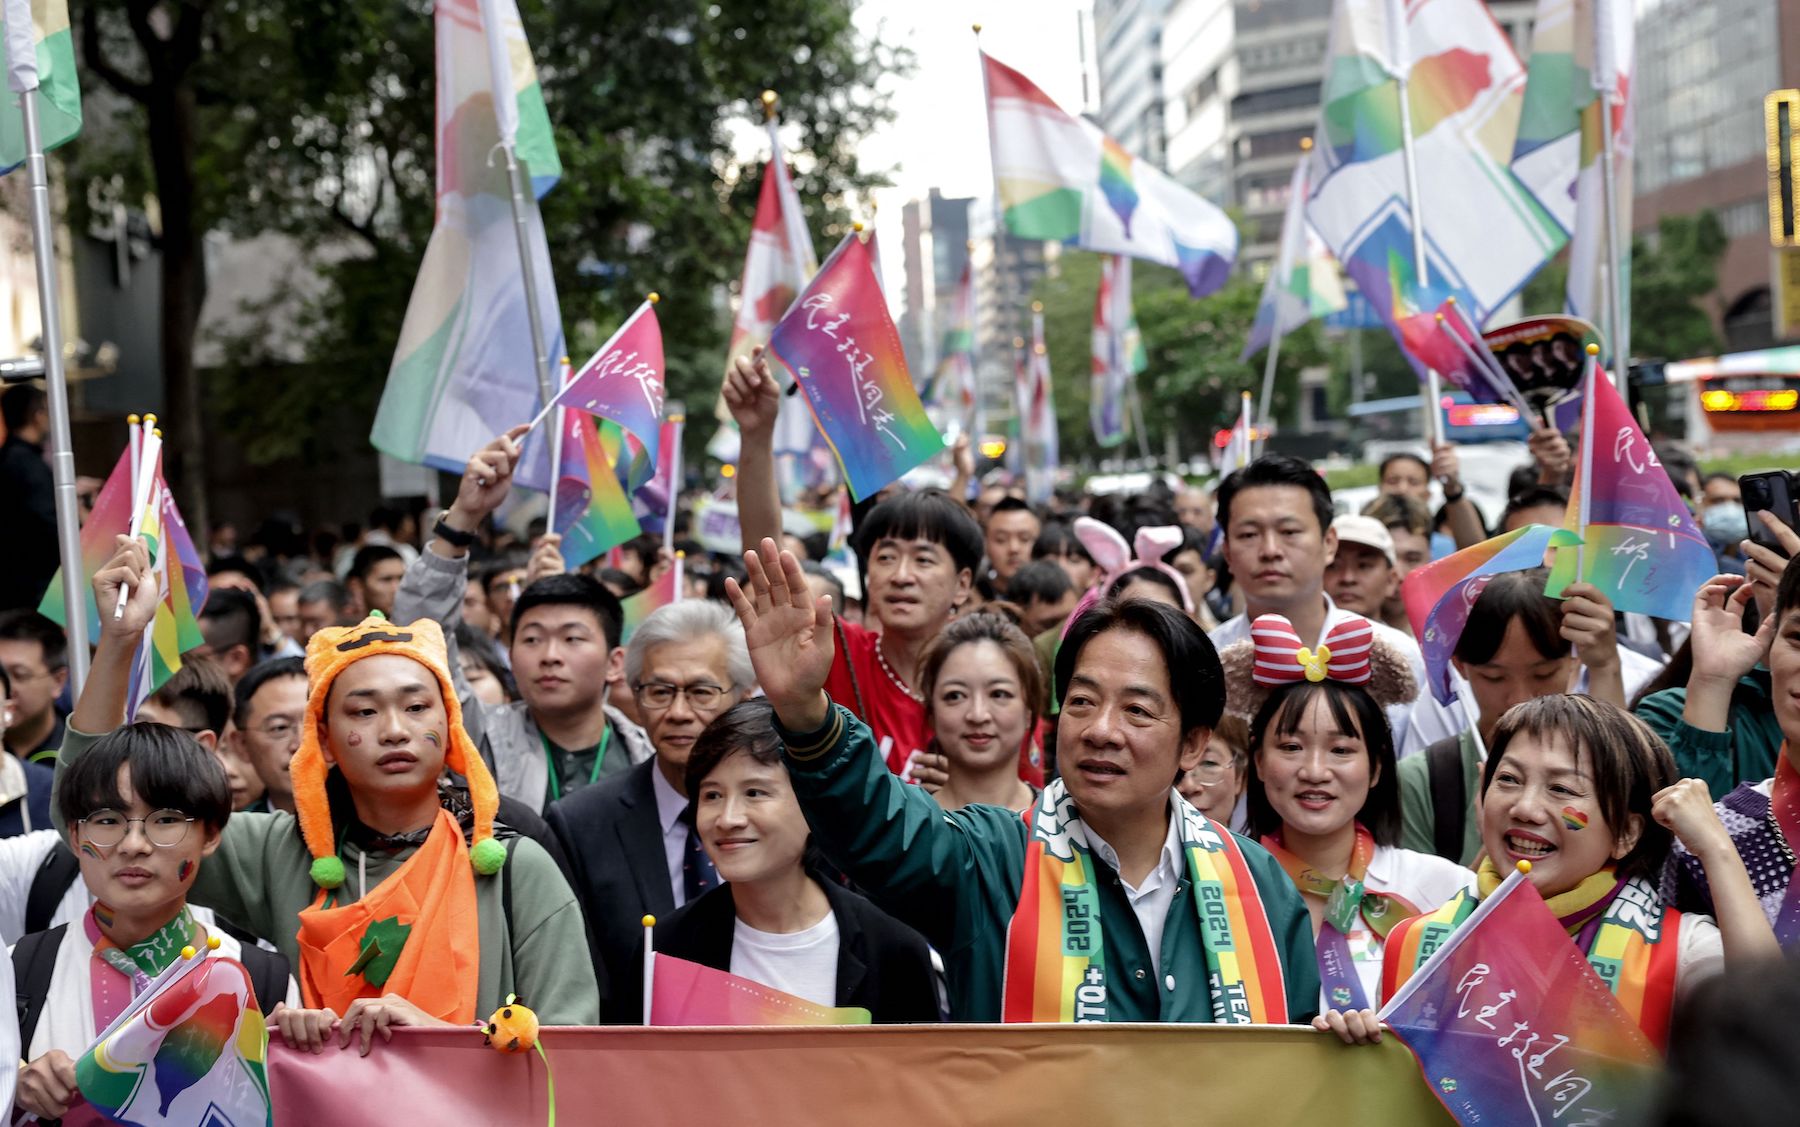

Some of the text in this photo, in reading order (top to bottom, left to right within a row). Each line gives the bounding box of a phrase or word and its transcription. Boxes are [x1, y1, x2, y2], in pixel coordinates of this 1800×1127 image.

[1064, 888, 1091, 951] 2024
[1201, 886, 1232, 947] 2024
[1227, 983, 1252, 1024] TEA
